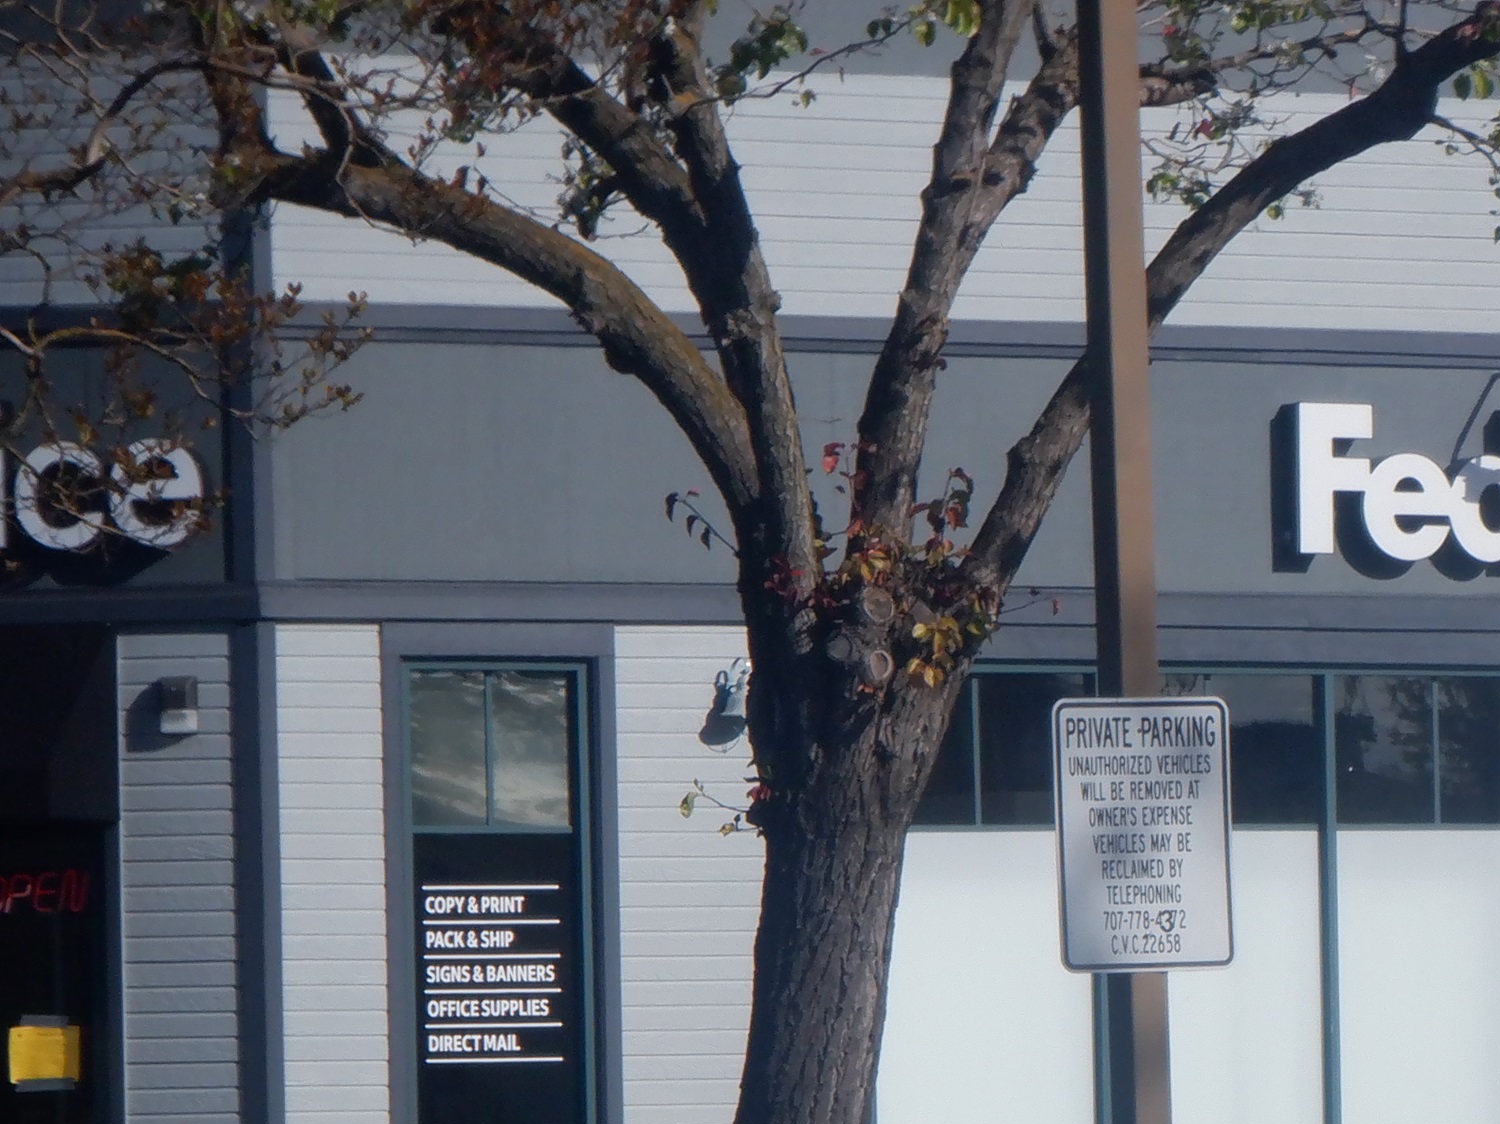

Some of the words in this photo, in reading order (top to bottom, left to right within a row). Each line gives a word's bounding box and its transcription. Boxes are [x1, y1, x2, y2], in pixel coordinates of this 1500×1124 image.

[1065, 717, 1132, 749] PRIVATE
[1141, 715, 1216, 748] PARKING
[1068, 756, 1152, 776] UNAUTHORIZED
[1156, 754, 1211, 774] VEHICLES
[1081, 782, 1106, 802] WILL
[1110, 781, 1125, 801] BE
[1130, 781, 1182, 800] REMOVED
[1187, 780, 1200, 799] AT
[1089, 807, 1137, 828] OWNER'S
[1142, 805, 1193, 826] EXPENSE
[1092, 834, 1145, 854] VEHICLES
[1150, 833, 1172, 852] MAY
[1177, 832, 1192, 852] BE
[1102, 860, 1164, 879] RECLAIMED
[1169, 859, 1183, 878] BY
[0, 870, 89, 912] PEN
[1106, 885, 1181, 904] TELEPHONING
[424, 896, 464, 914] COPY
[467, 896, 478, 914] &
[481, 896, 525, 913] PRINT
[425, 931, 464, 948] PACK
[466, 931, 478, 948] &
[481, 931, 514, 947] SHIP
[426, 965, 470, 983] SIGNS
[472, 965, 484, 983] &
[486, 965, 555, 982] BANNERS
[427, 1000, 479, 1017] OFFICE
[481, 999, 549, 1017] SUPPLIES
[428, 1035, 481, 1052] DIRECT
[483, 1034, 521, 1051] MAIL
